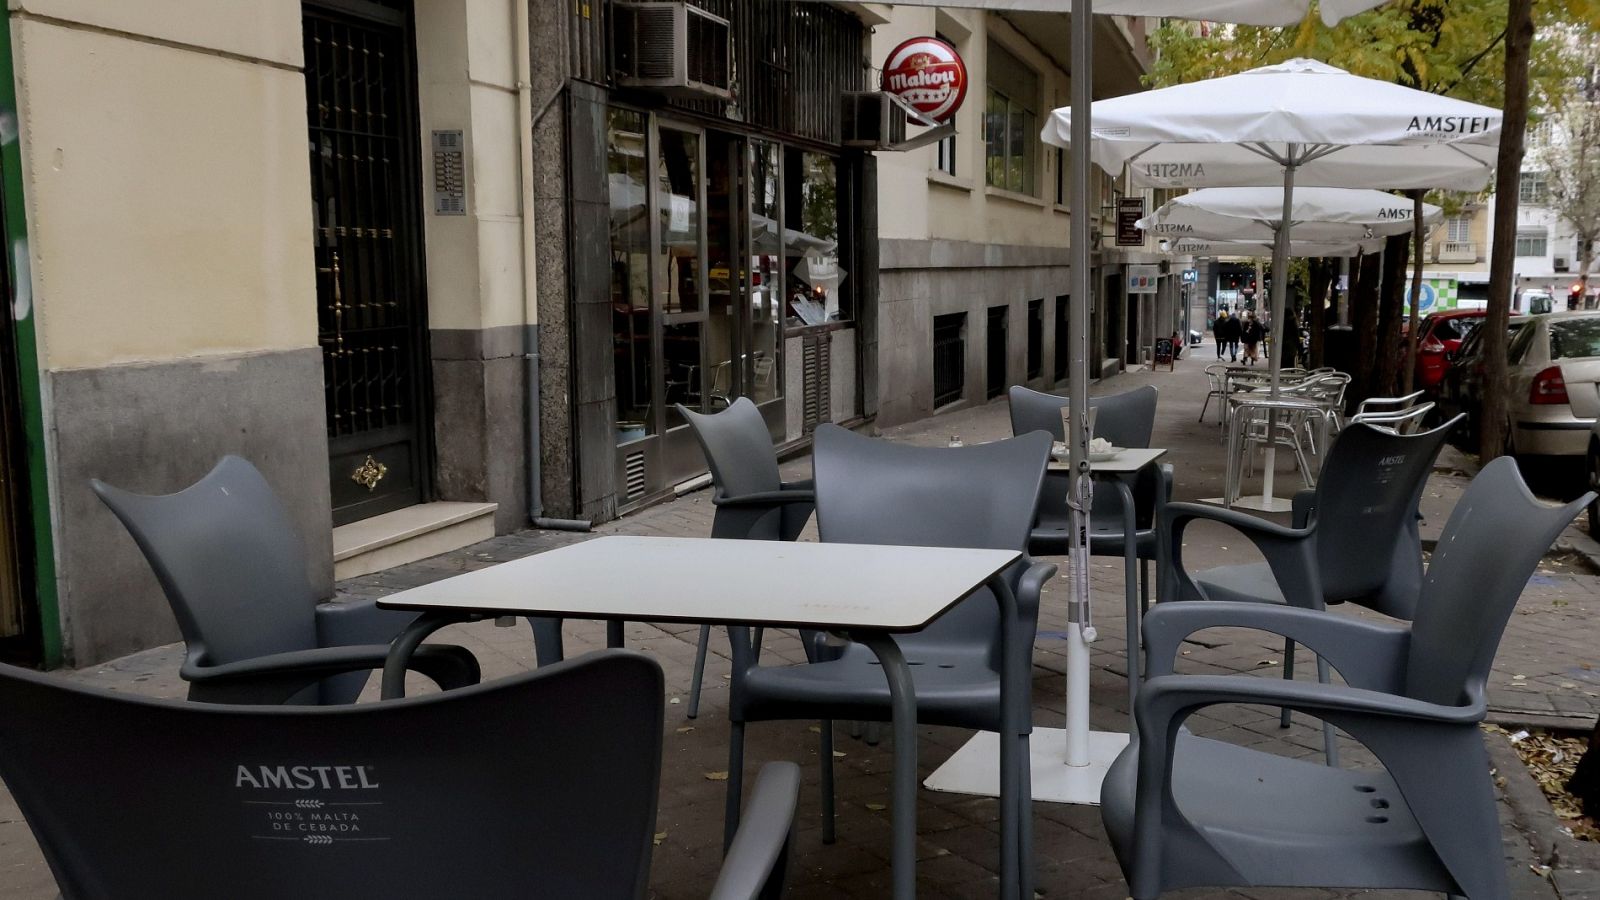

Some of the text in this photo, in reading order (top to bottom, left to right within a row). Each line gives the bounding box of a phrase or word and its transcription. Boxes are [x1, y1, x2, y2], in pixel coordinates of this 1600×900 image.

[889, 69, 955, 90] Mahou
[1377, 207, 1413, 219] AMST
[235, 764, 379, 789] AMSTEL
[267, 811, 360, 821] 100% MALTA
[273, 822, 361, 832] DE CEBADA
